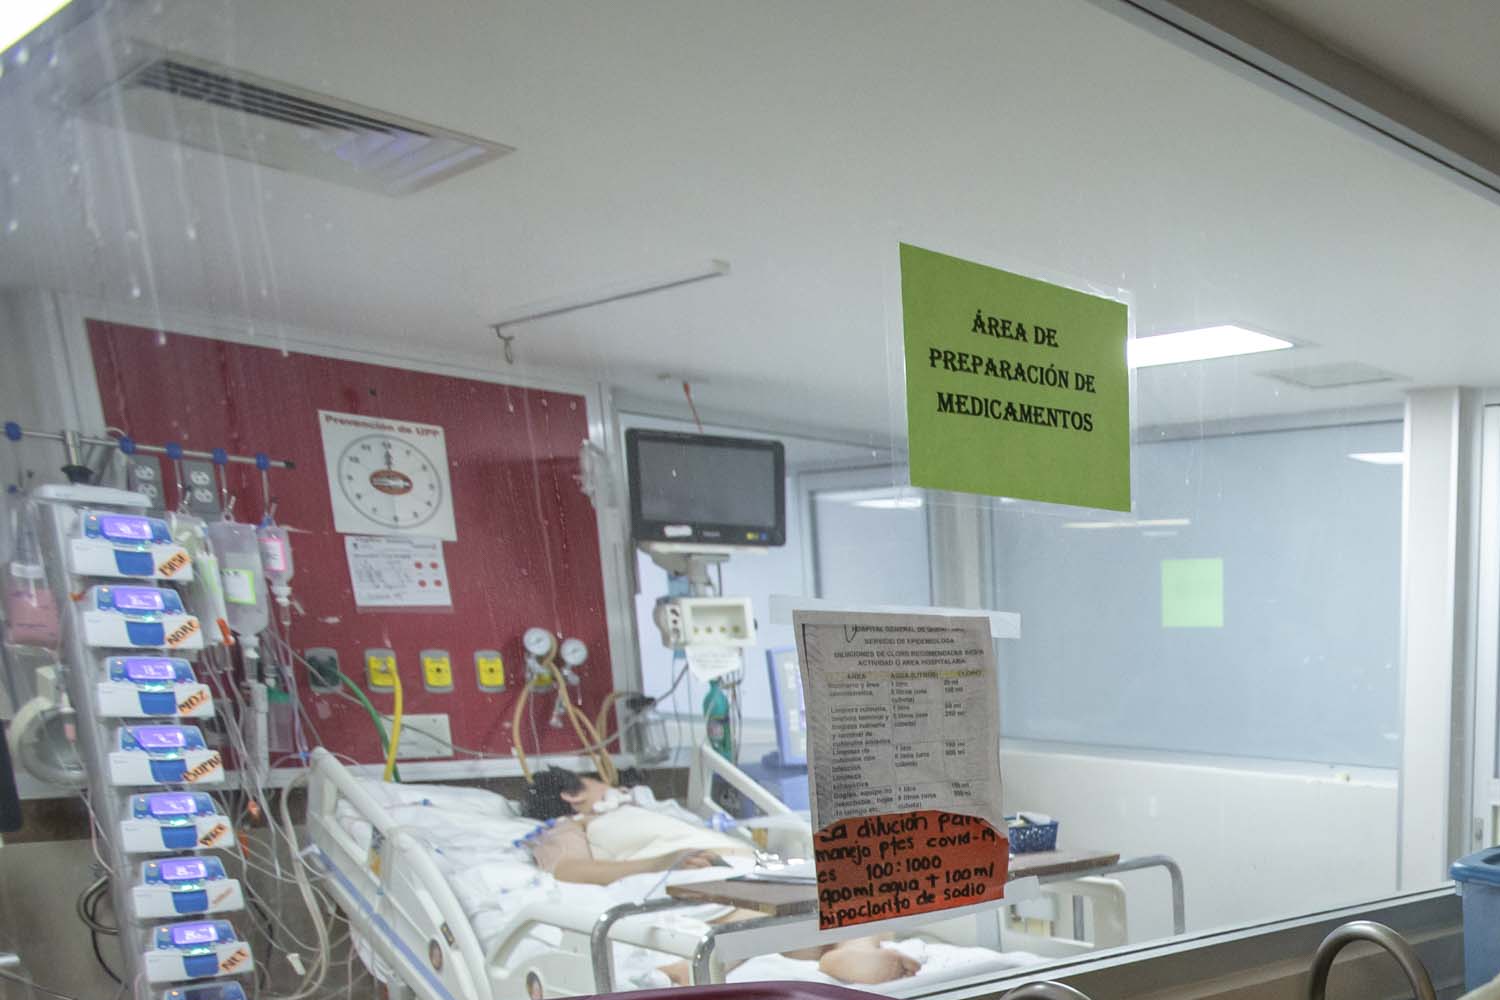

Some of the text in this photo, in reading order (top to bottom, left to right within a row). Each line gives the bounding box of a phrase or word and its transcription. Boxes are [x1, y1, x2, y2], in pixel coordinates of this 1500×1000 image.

[971, 309, 1059, 348] ÁREA DE
[929, 348, 1096, 394] PREPARACIÓN DE
[937, 391, 1093, 432] MEDICAMENTOS
[816, 841, 871, 865] manejo
[817, 869, 837, 883] es
[879, 879, 919, 897] agua
[820, 883, 986, 927] hipoclorito de sodio
